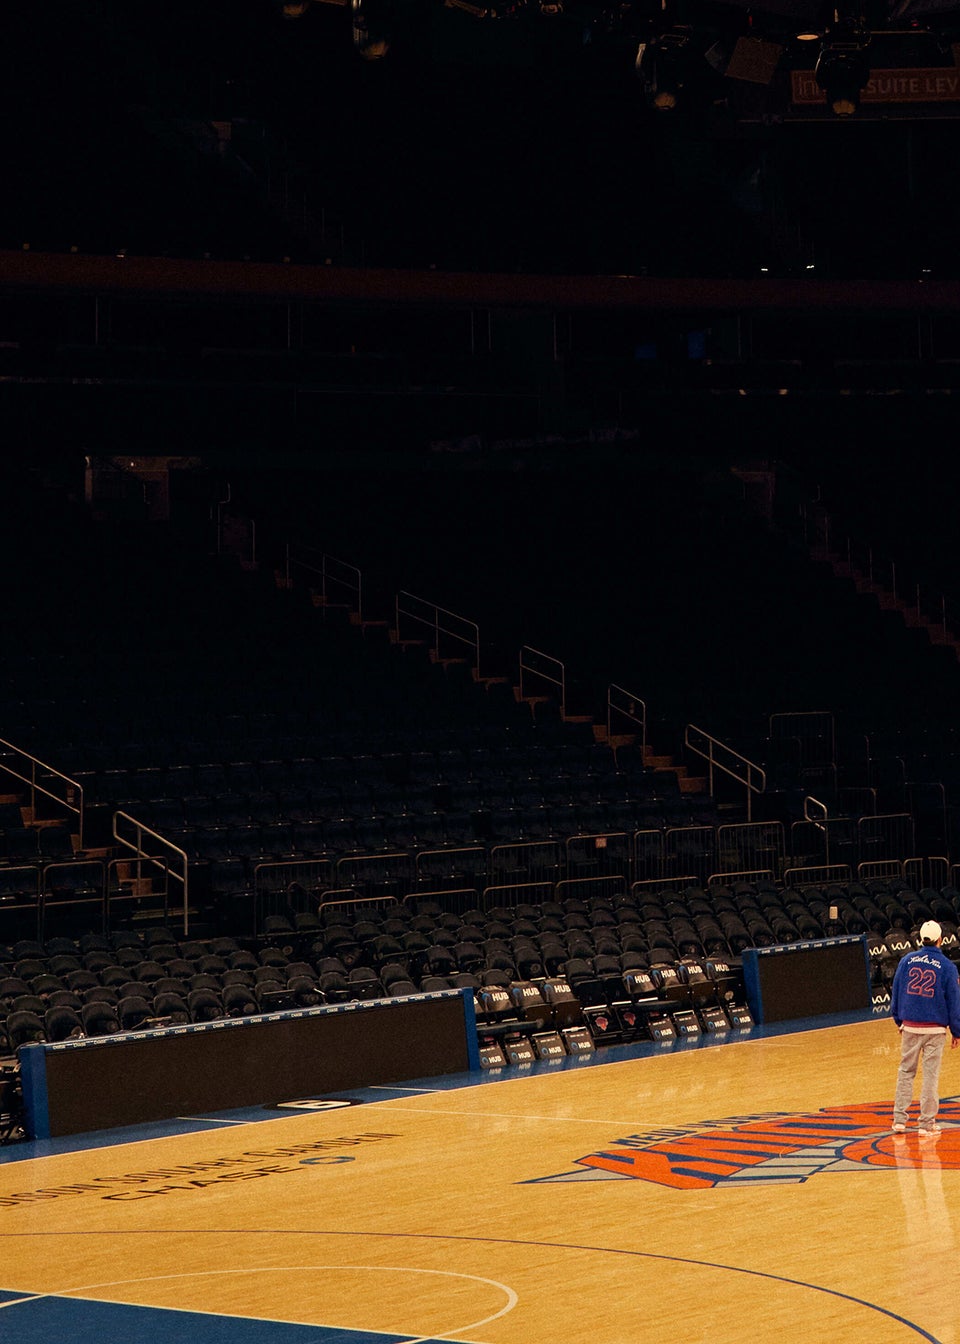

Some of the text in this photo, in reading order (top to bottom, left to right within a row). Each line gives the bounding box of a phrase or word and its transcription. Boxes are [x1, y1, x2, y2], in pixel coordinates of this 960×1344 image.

[866, 78, 920, 94] SUITE
[687, 965, 703, 974] HUB
[715, 963, 730, 972] HUB
[660, 968, 677, 978] HUB
[633, 974, 651, 984] HUB
[907, 966, 937, 998] 22
[522, 987, 540, 997] HUB
[553, 984, 572, 994] HUB
[491, 991, 510, 1002] HUB
[713, 1020, 726, 1028] HUB
[739, 1015, 751, 1024] HUB
[660, 1028, 673, 1037] HUB
[686, 1025, 698, 1033] HUB
[577, 1041, 591, 1049] HUB
[548, 1046, 562, 1054] HUB
[488, 1055, 502, 1064] HUB
[517, 1051, 531, 1060] HUB
[608, 1128, 698, 1148] NEW
[243, 1132, 404, 1159] GARDEN
[101, 1165, 305, 1201] CHASE
